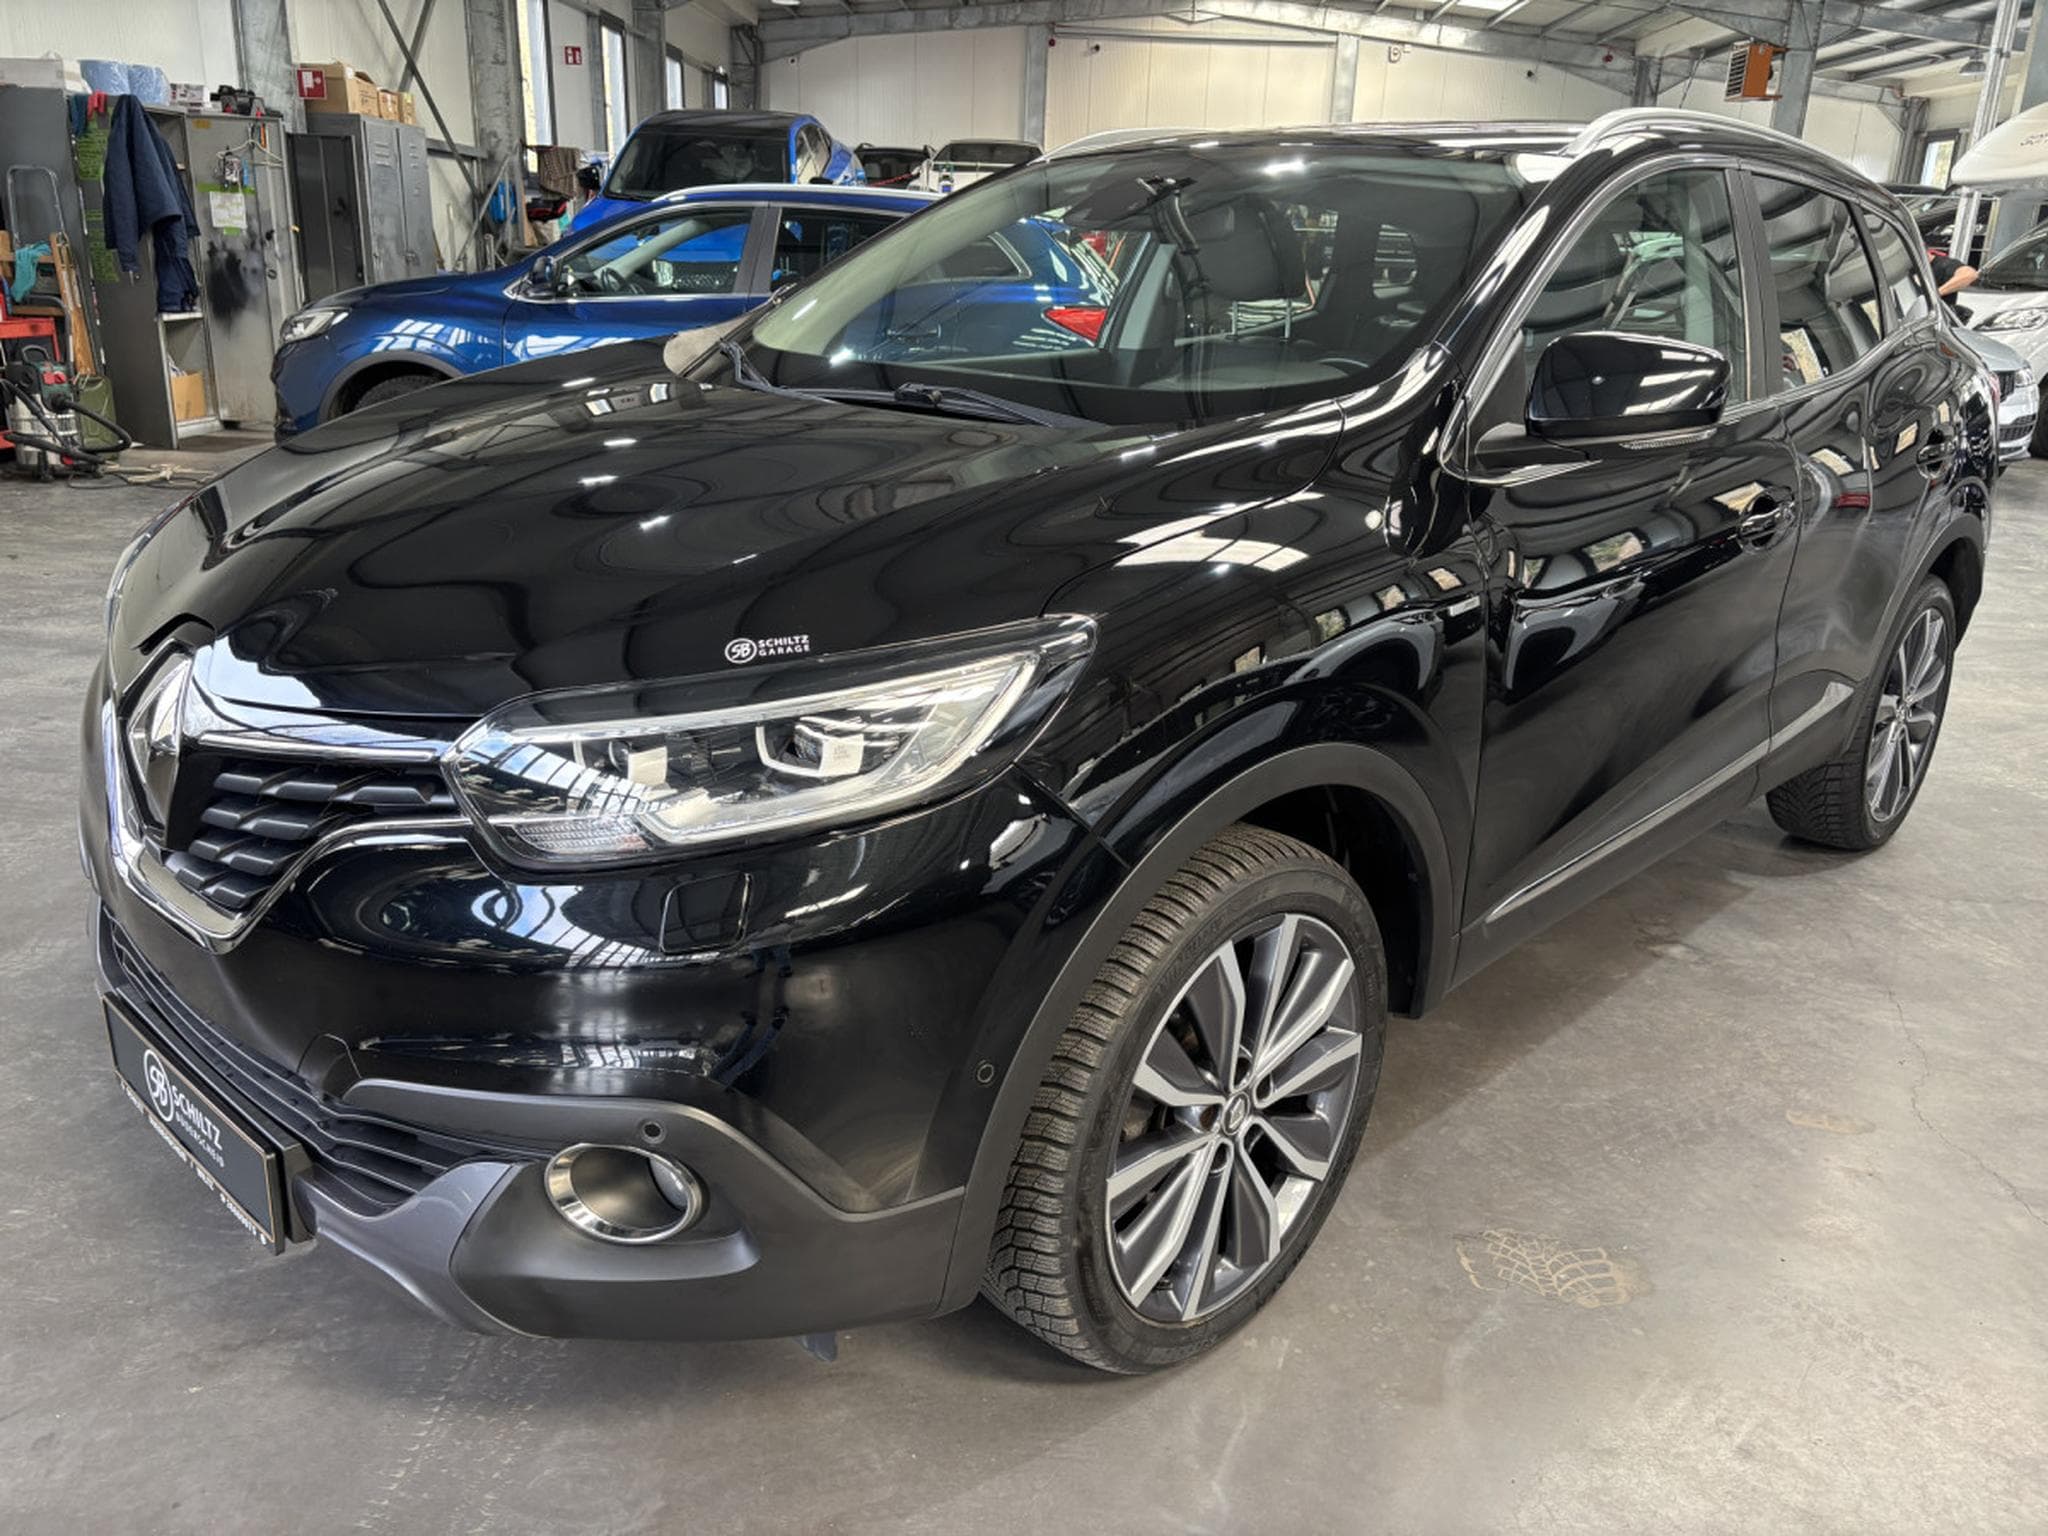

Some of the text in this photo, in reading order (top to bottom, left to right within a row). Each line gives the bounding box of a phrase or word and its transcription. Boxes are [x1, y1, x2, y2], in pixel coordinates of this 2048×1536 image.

[758, 634, 810, 648] SCHILTZ
[758, 644, 810, 656] GARAGE
[172, 1085, 223, 1151] SCHILTZ
